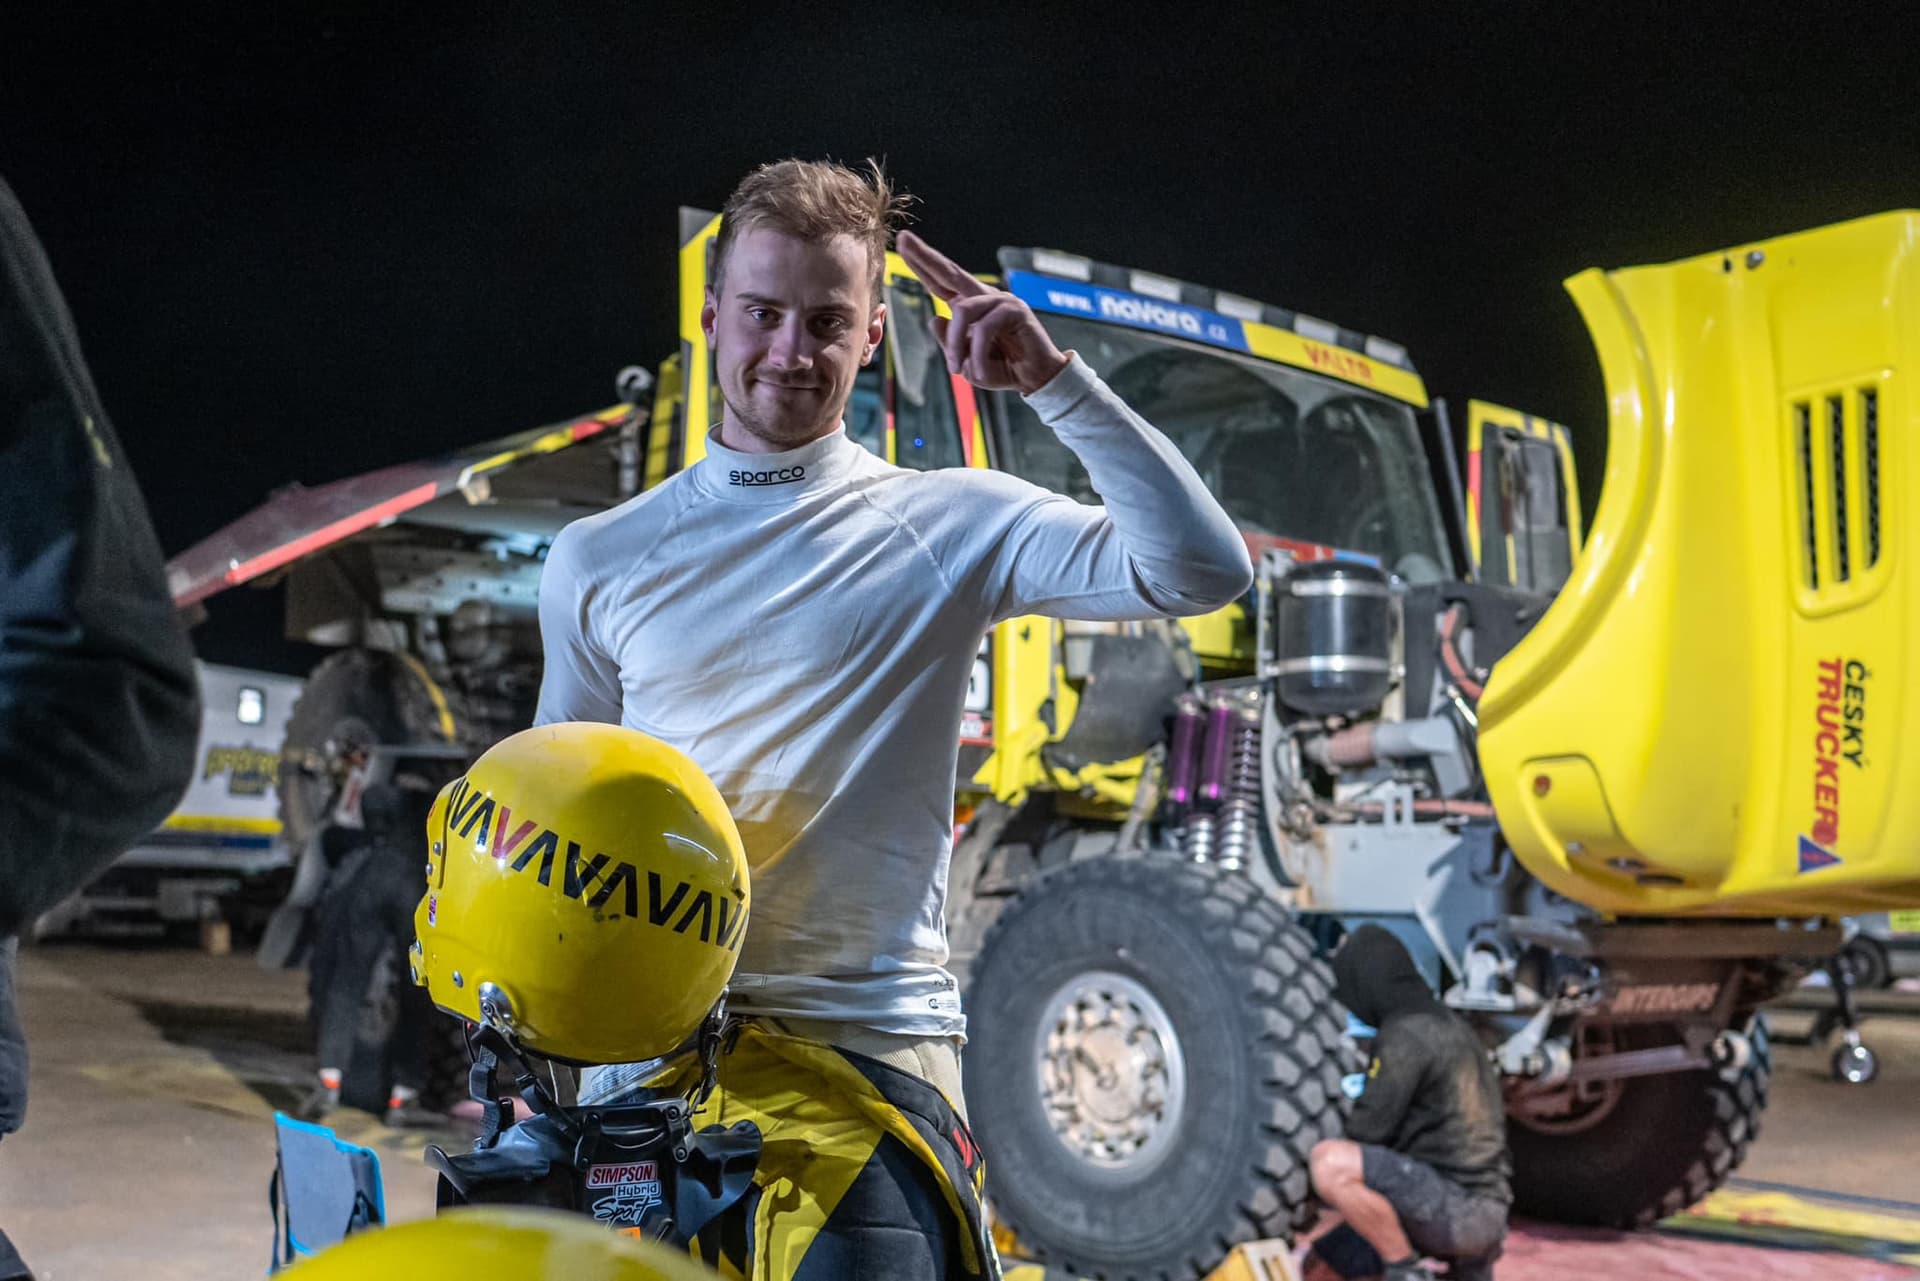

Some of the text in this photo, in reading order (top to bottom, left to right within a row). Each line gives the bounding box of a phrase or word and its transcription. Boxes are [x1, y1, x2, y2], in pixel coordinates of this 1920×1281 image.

[729, 466, 805, 487] sparco
[592, 1165, 653, 1185] SIMPSON
[617, 1184, 657, 1199] Hybrid
[594, 1196, 661, 1226] Sport
